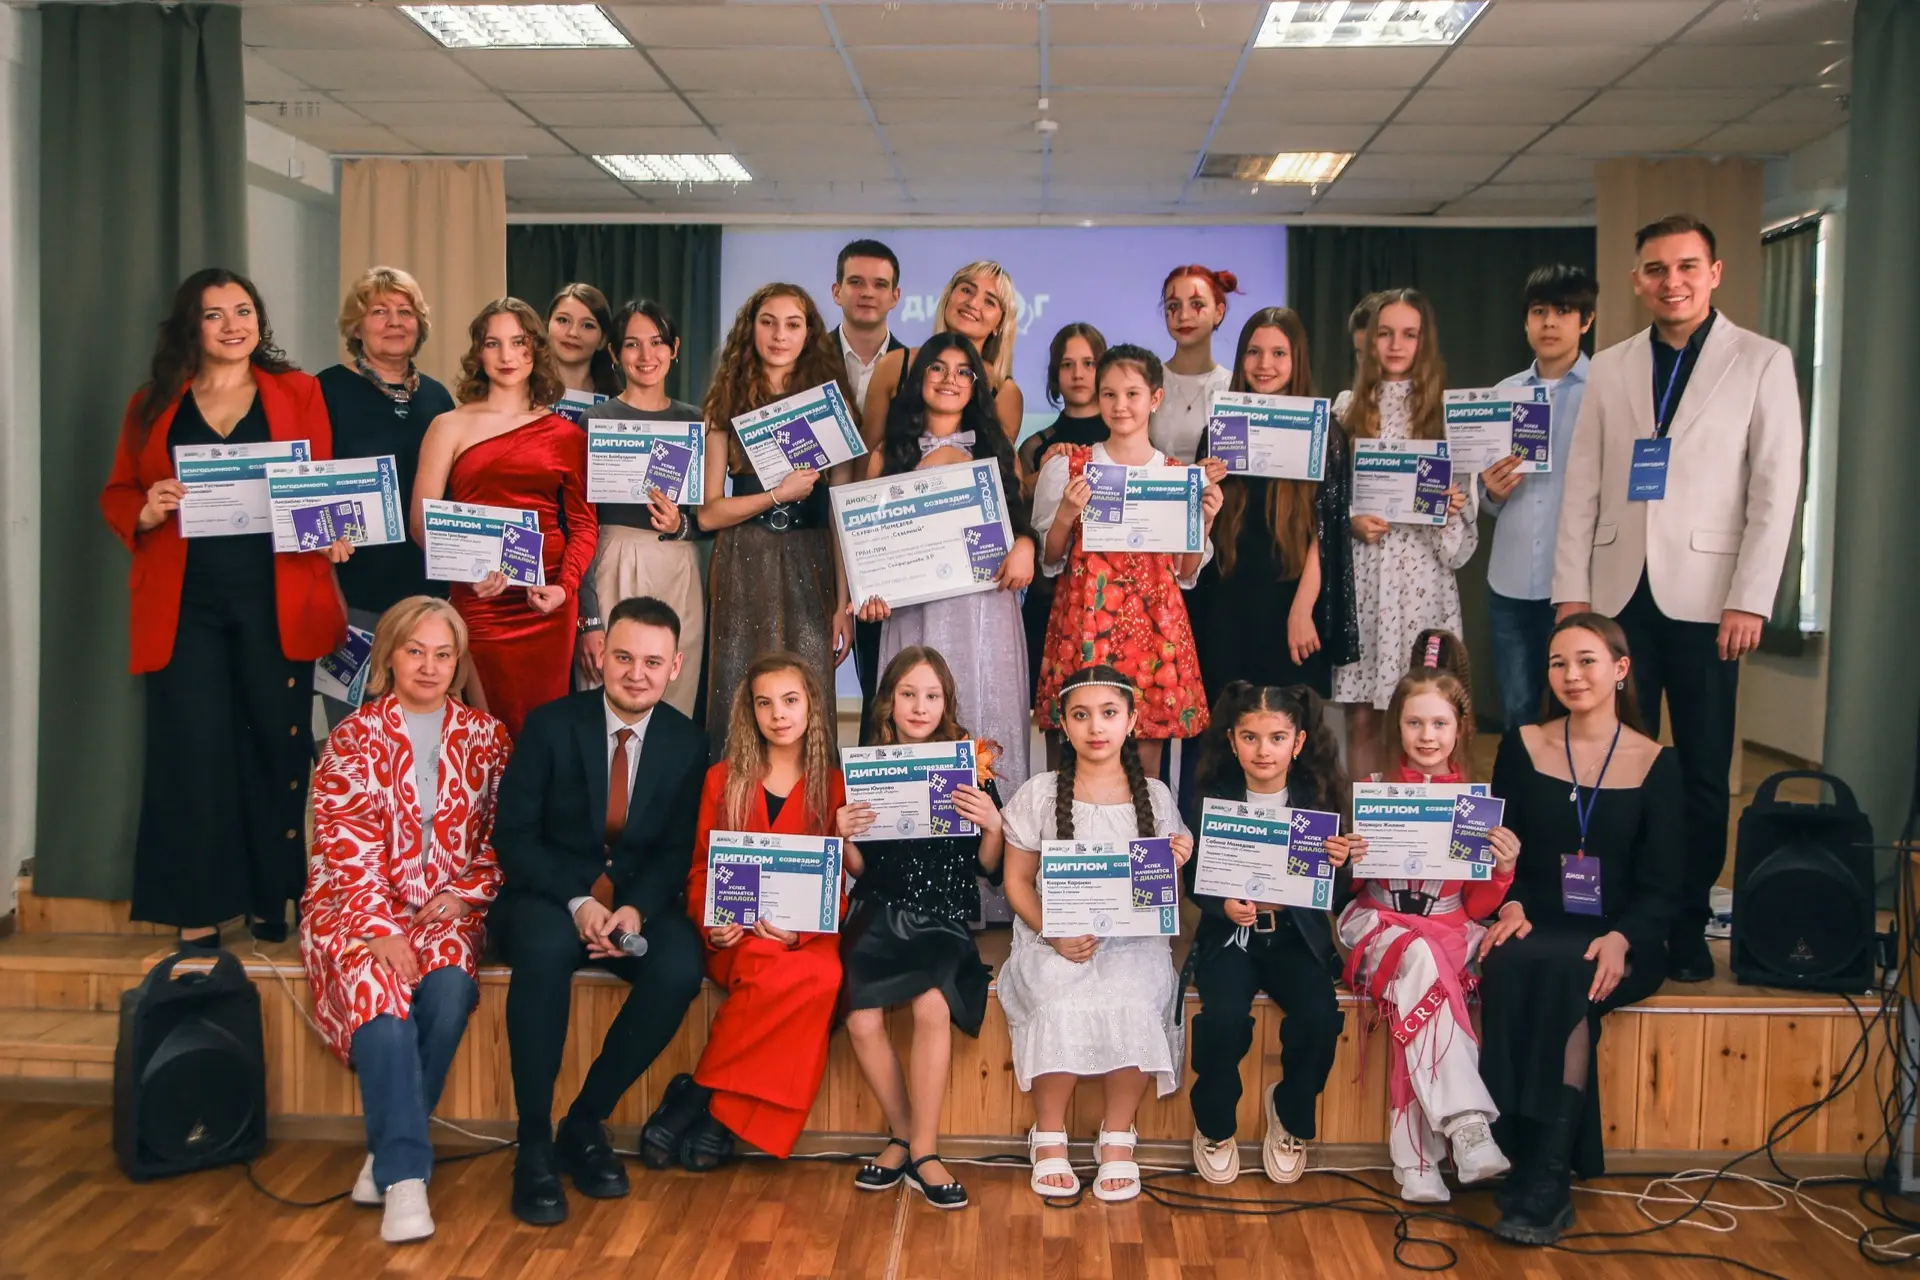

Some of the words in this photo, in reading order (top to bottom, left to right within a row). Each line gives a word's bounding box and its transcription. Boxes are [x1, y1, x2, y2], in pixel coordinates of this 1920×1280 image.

[1448, 408, 1494, 418] ДИПЛОМ
[592, 438, 644, 448] ДИПЛОМ
[1357, 458, 1400, 466] ДИПЛОМ
[848, 504, 916, 526] ДИПЛОМ
[924, 494, 970, 507] созвездие
[428, 518, 481, 529] ДИПЛОМ
[849, 766, 908, 779] ДИПЛОМ
[1358, 805, 1419, 814] ДИПЛОМ
[1206, 821, 1267, 836] ДИПЛОМ
[713, 853, 773, 864] ДИПЛОМ
[1046, 862, 1107, 872] ДИПЛОМ
